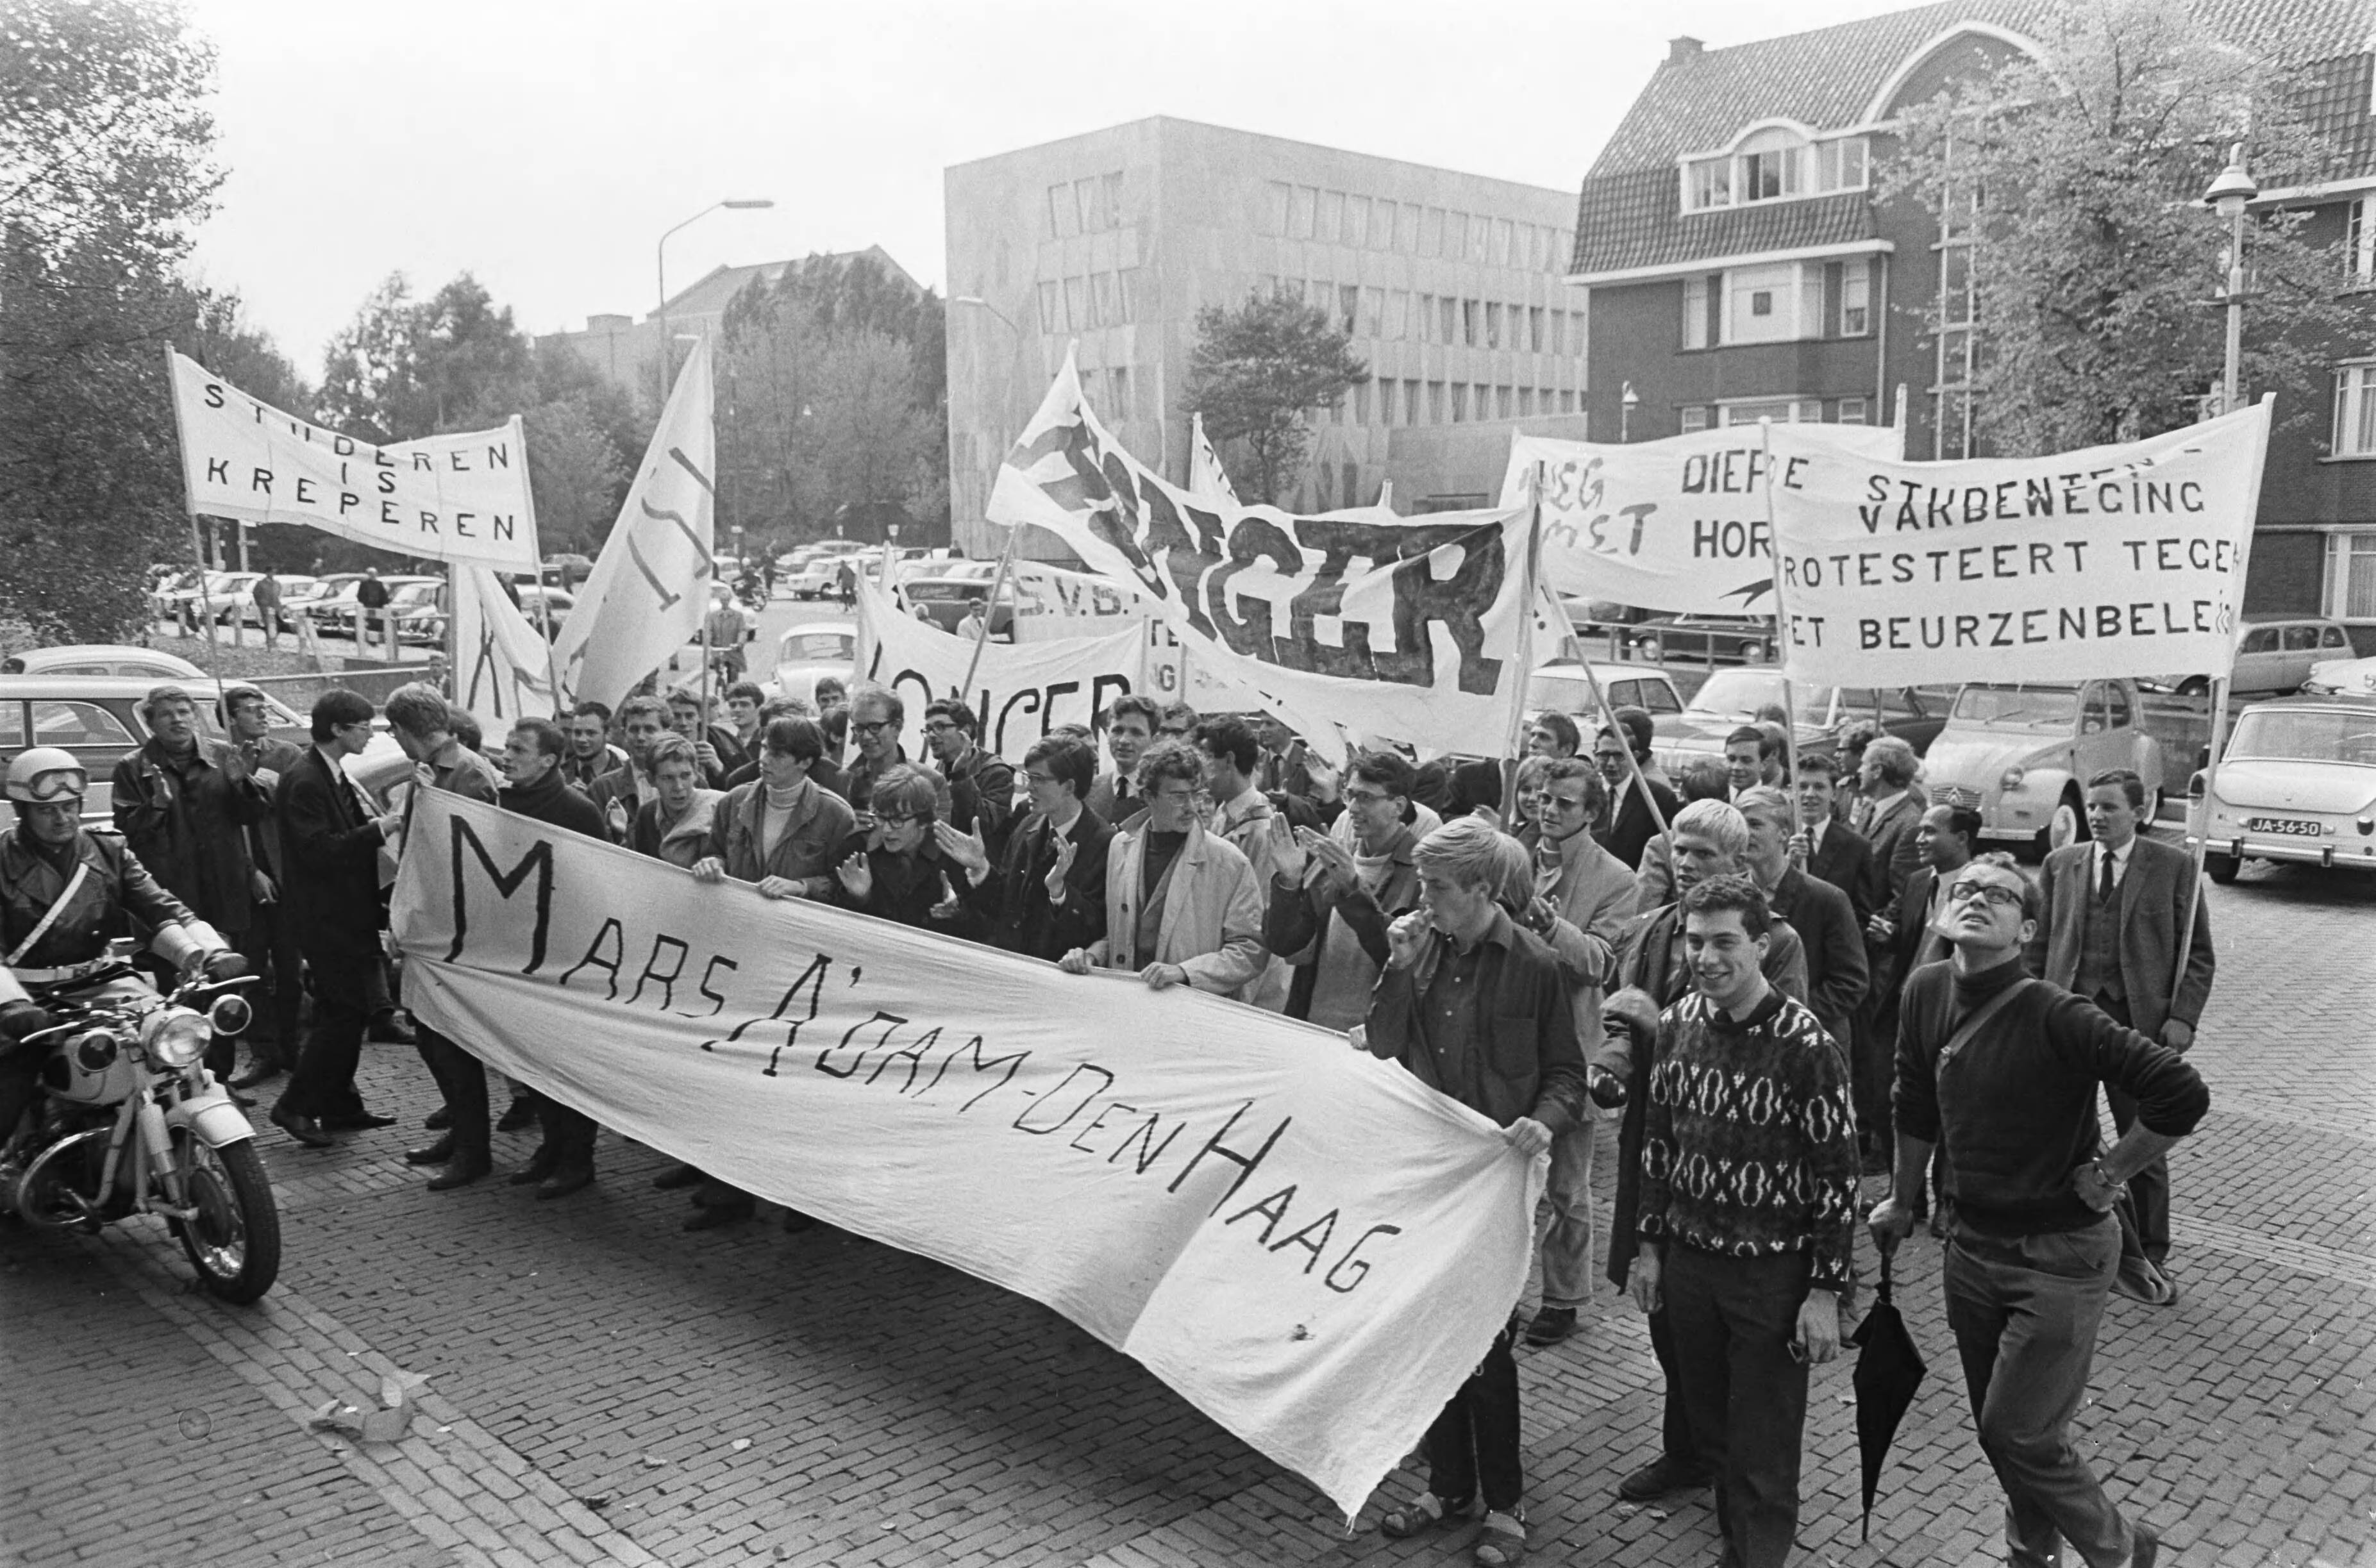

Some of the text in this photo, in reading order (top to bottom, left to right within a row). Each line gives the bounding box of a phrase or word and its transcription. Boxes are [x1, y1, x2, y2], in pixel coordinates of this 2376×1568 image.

[341, 461, 397, 494] IS
[206, 456, 514, 541] KREPEREN
[1778, 538, 2238, 587] ROTESTEERT TEGE
[1784, 615, 1825, 648] ET
[2252, 819, 2320, 836] JA-56-50
[442, 813, 739, 1018] MARS
[1166, 1097, 1402, 1294] HAAG
